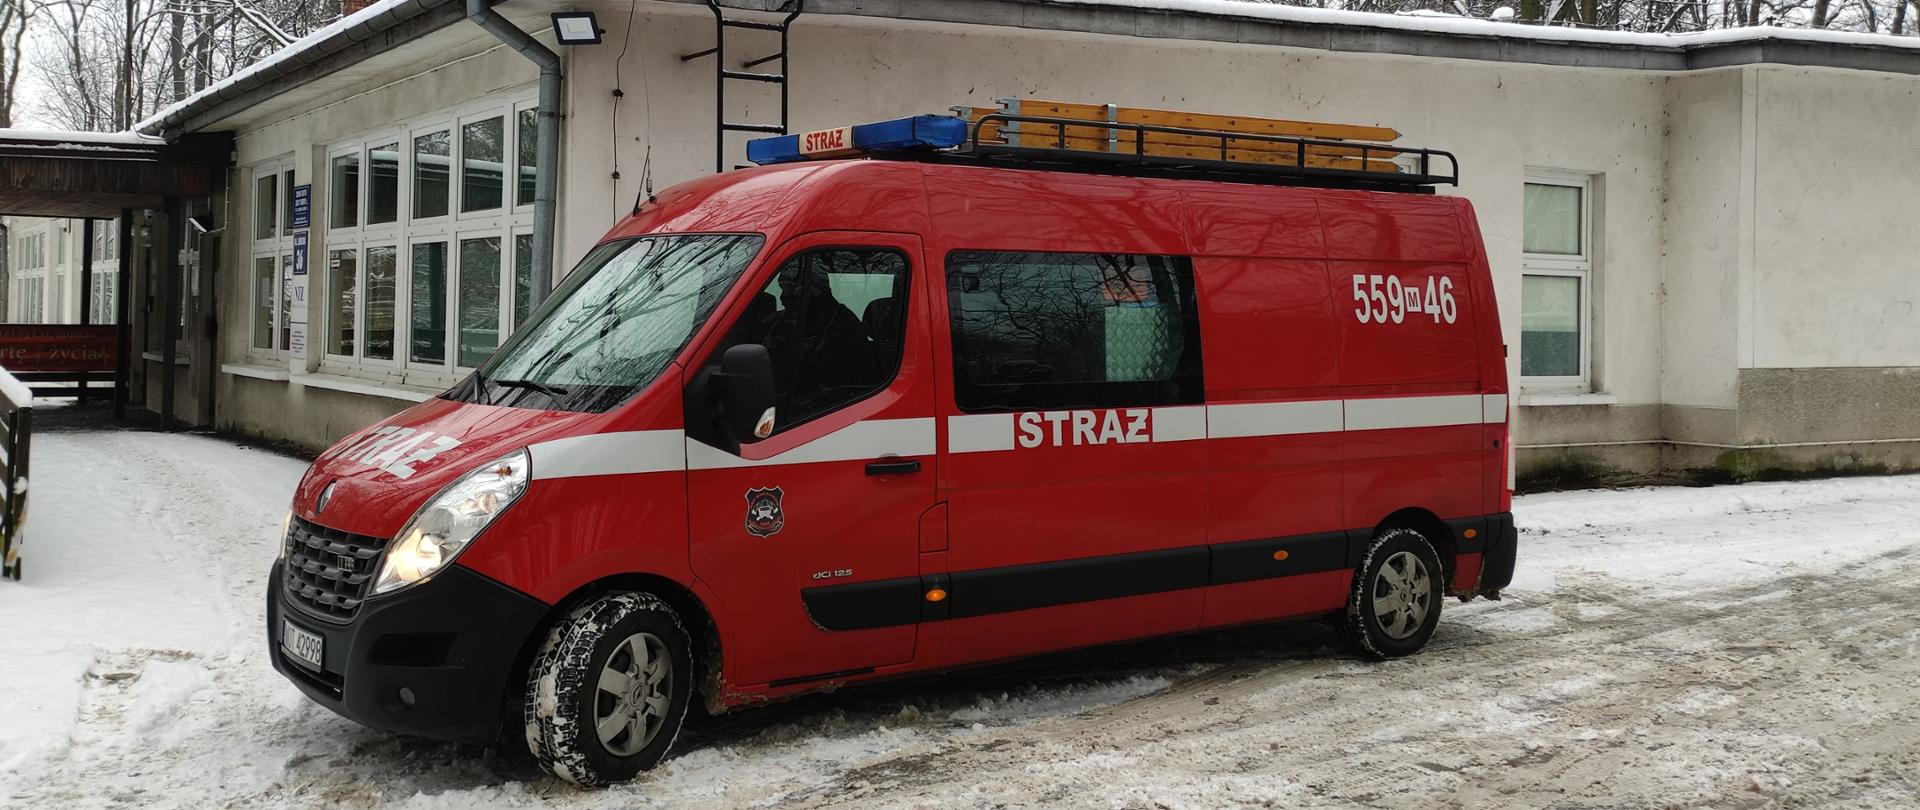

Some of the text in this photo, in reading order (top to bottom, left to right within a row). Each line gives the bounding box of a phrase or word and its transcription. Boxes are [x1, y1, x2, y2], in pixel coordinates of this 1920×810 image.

[1353, 274, 1457, 324] 559 M 46
[834, 568, 853, 576] 125
[297, 632, 321, 663] 42998
